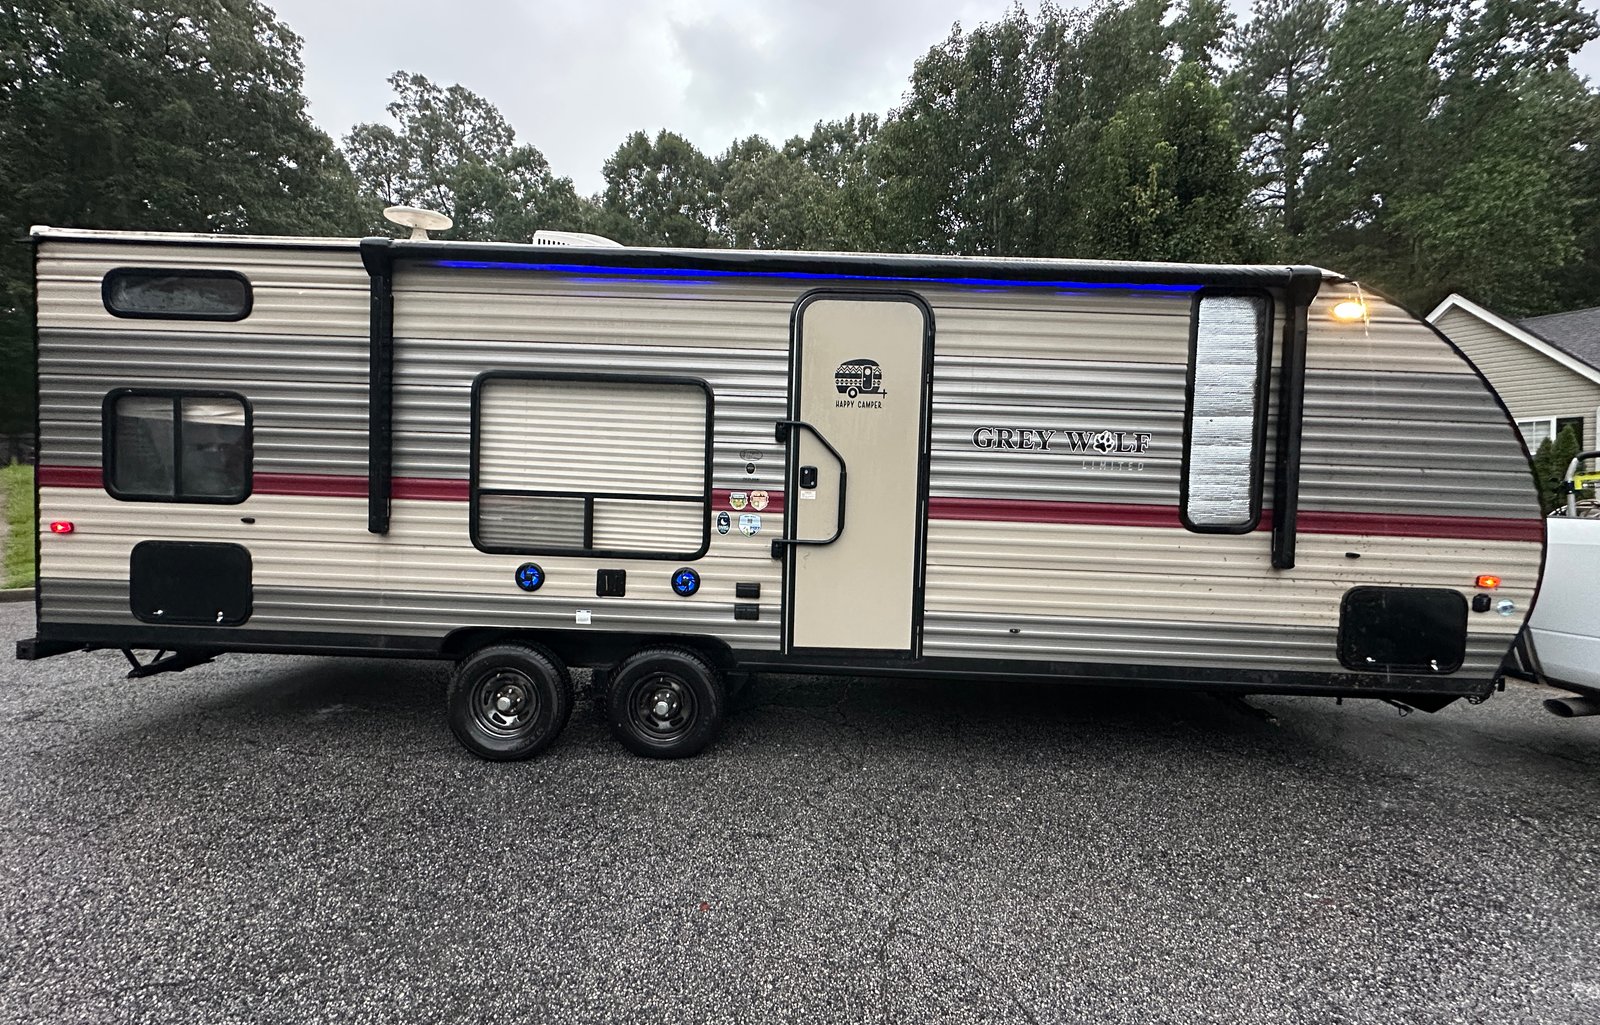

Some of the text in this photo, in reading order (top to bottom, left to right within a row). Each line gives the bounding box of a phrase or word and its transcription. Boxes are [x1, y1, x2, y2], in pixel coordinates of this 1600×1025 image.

[835, 400, 883, 409] HAPPY CAMPER
[972, 427, 1056, 450] GREY
[1081, 460, 1144, 472] LIMITED
